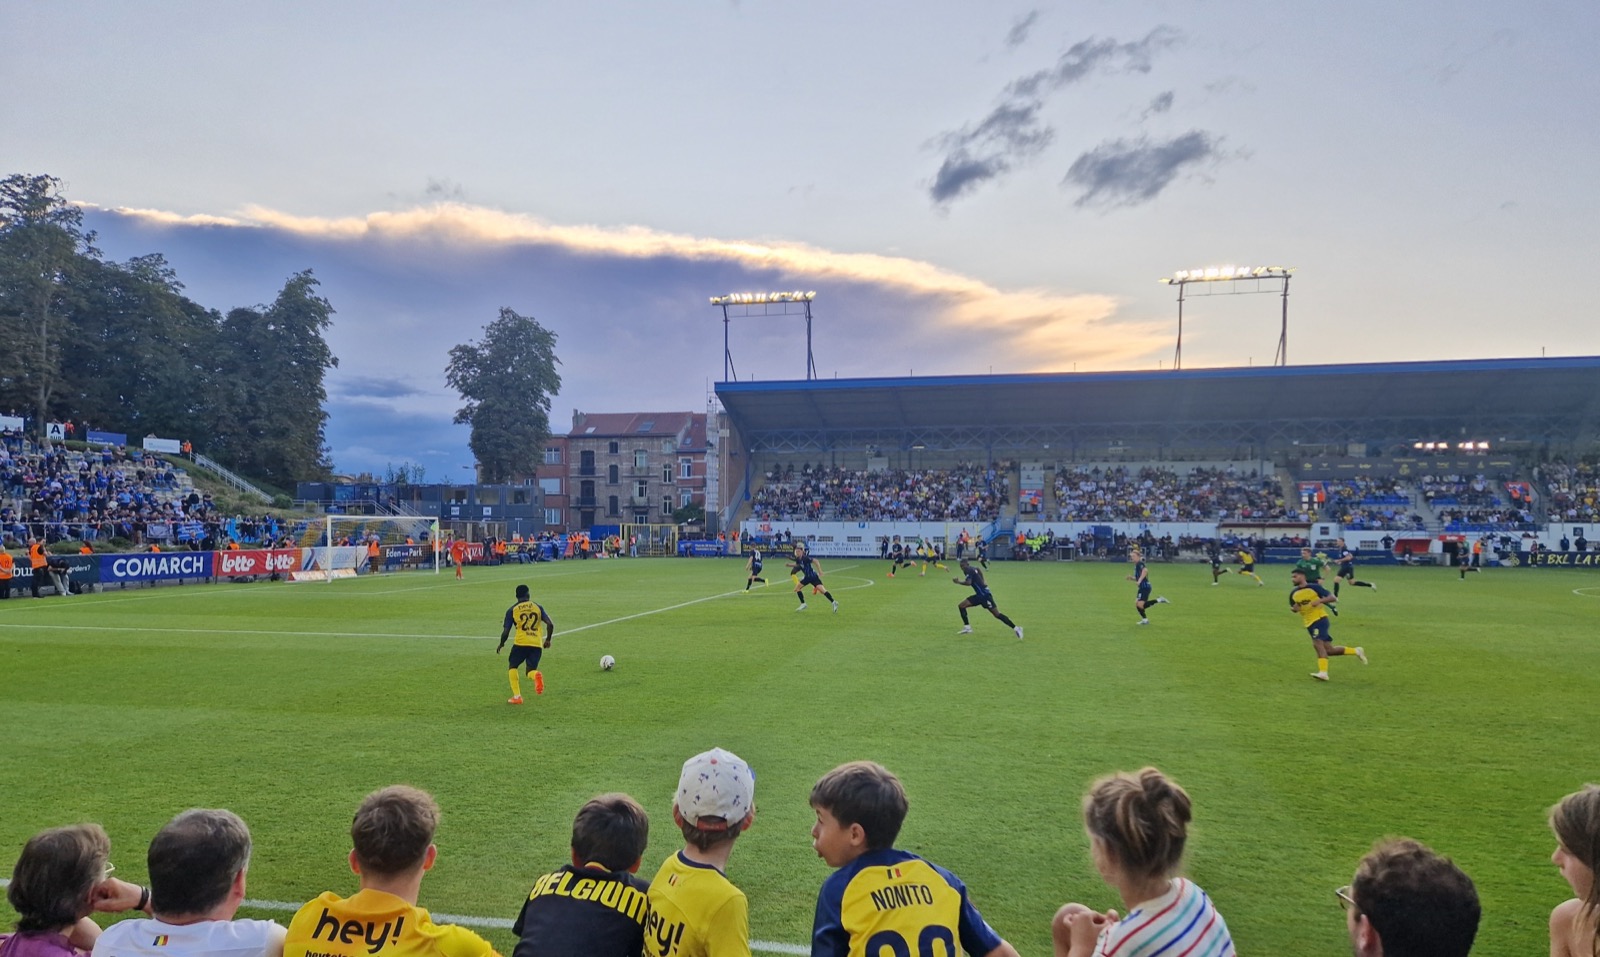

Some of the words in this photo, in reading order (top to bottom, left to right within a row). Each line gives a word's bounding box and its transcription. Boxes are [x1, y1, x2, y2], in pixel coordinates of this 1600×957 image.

[51, 424, 61, 434] A
[386, 548, 401, 557] Eden
[409, 548, 423, 557] Park
[1547, 553, 1570, 565] BXL
[1574, 553, 1592, 565] LA
[69, 564, 91, 572] orders?
[112, 556, 204, 577] COMARCH
[520, 612, 539, 632] 22
[529, 871, 648, 926] BELGIUM
[870, 884, 934, 911] NONITO
[312, 908, 405, 954] hey!
